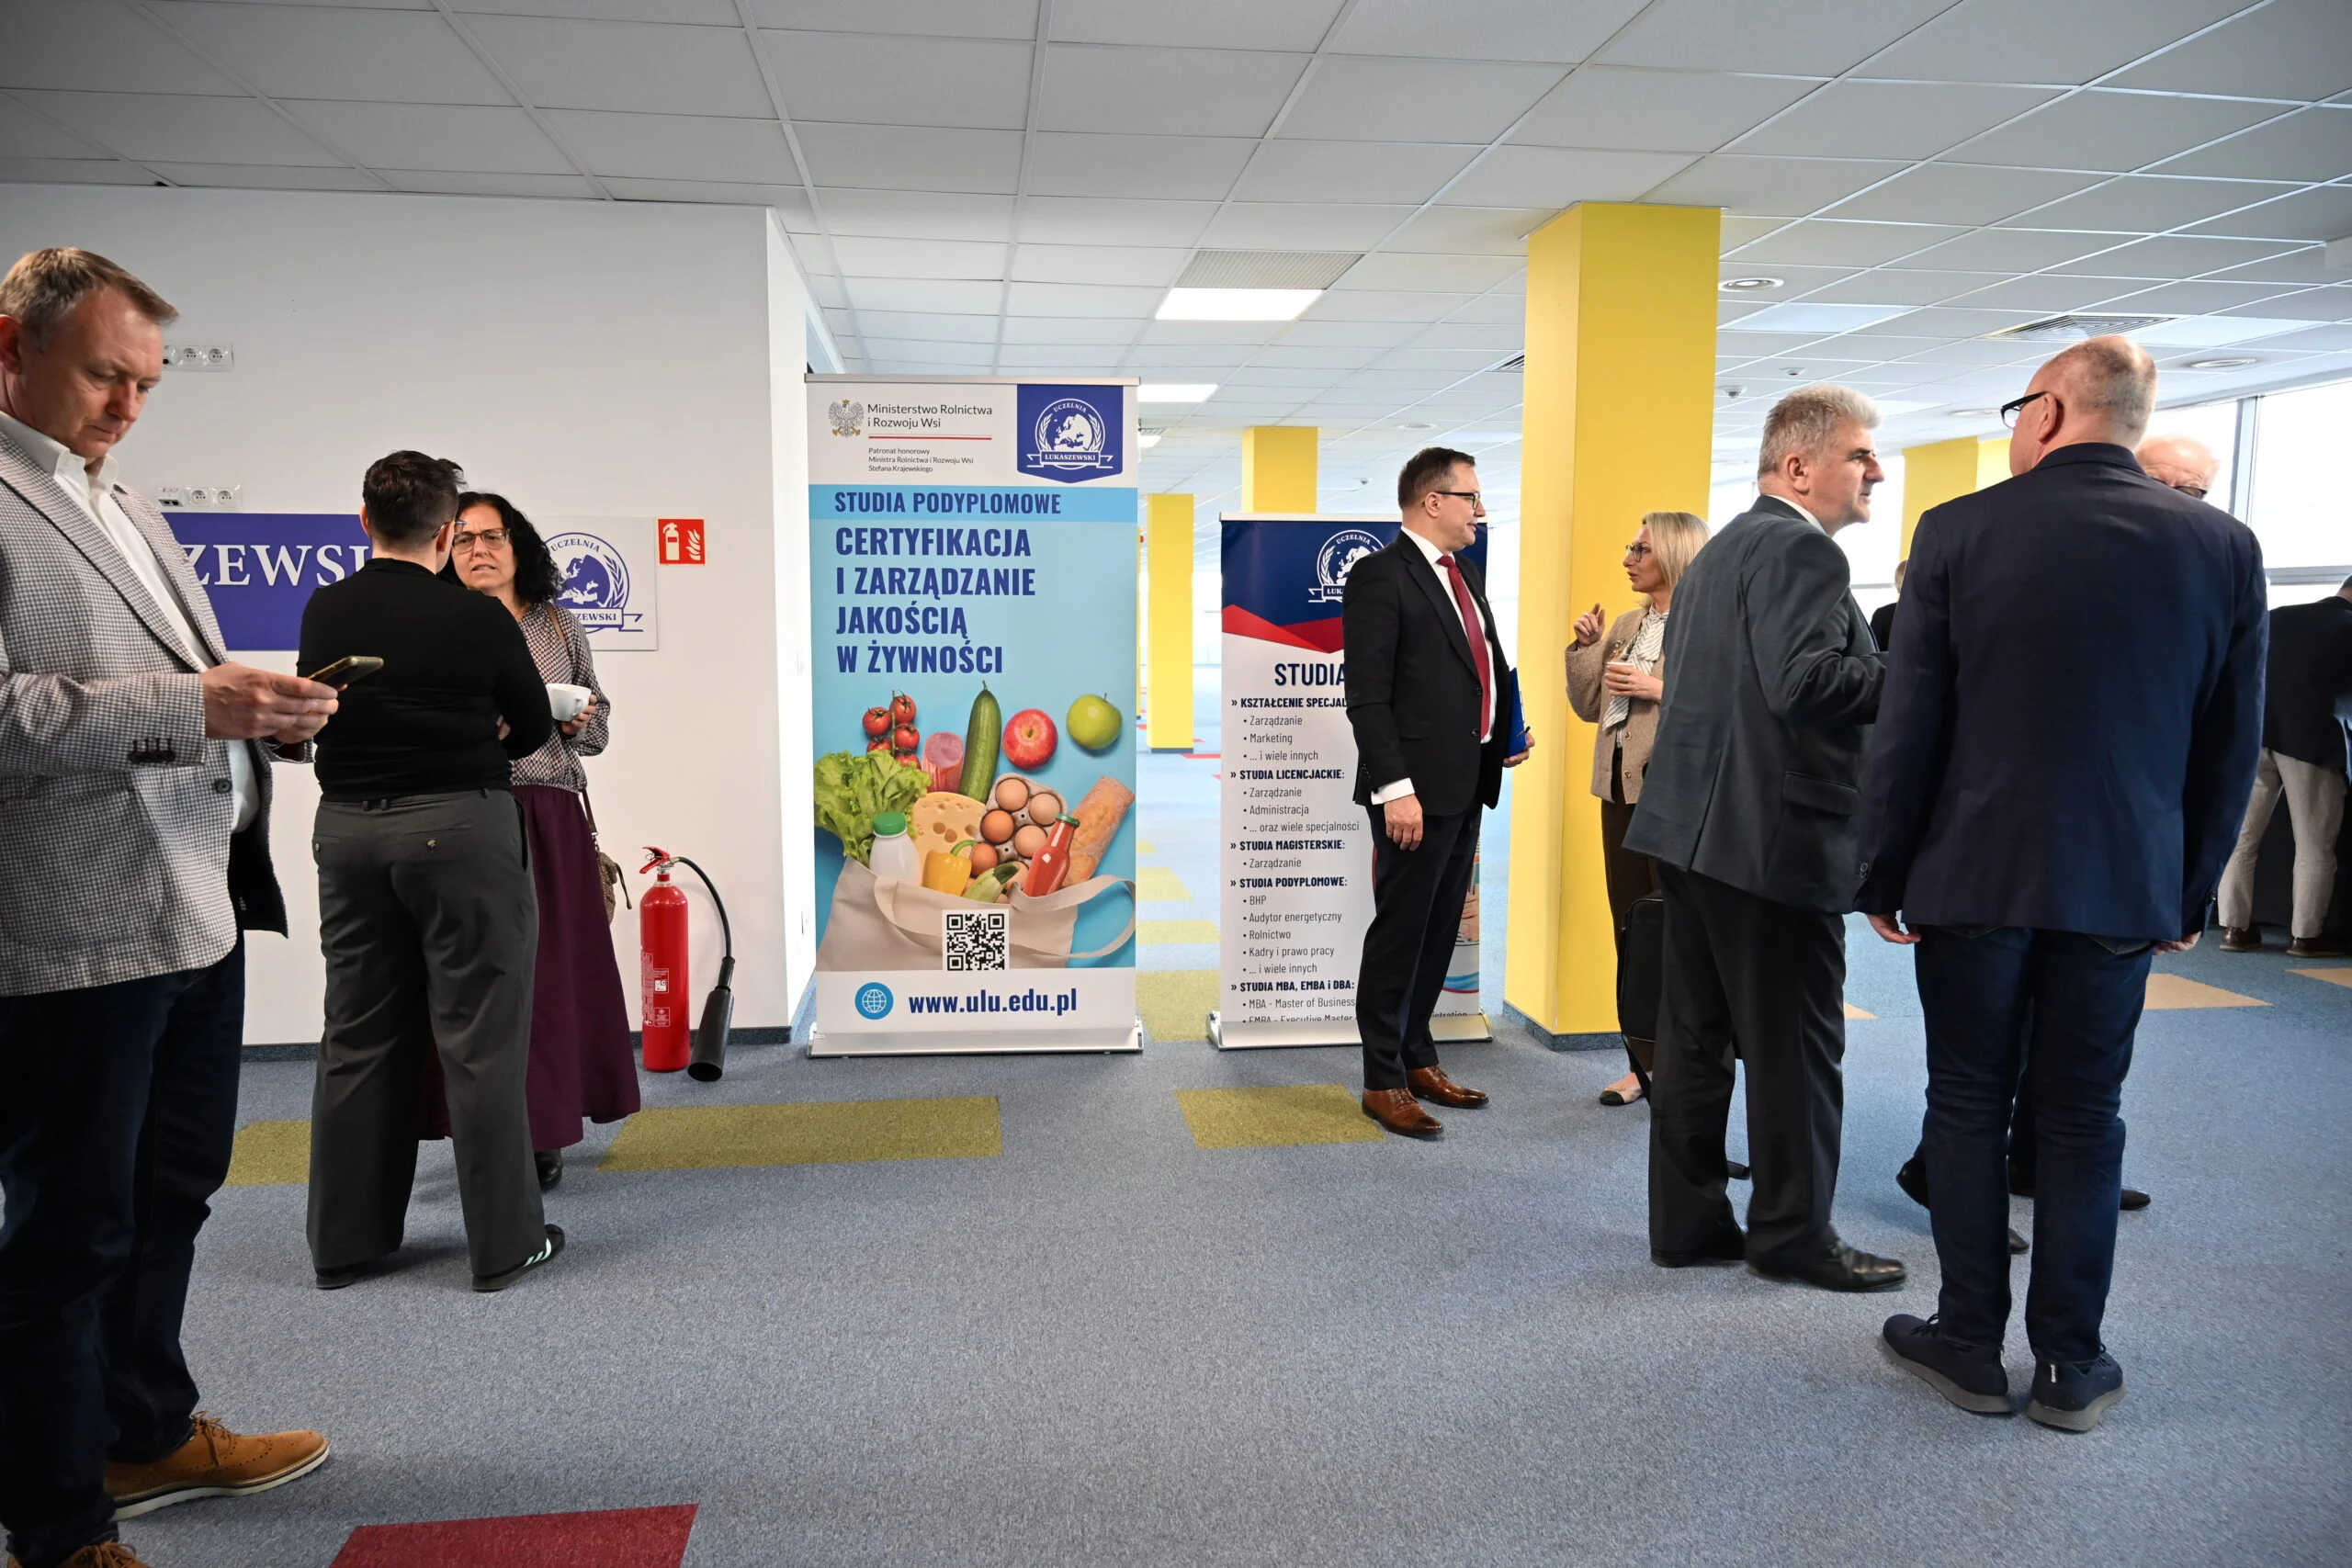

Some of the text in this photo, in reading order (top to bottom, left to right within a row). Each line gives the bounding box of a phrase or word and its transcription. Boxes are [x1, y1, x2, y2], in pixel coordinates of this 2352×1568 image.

[867, 404, 992, 415] Ministerstwo Rolnictwa
[1053, 402, 1087, 413] UCZELNIA
[867, 417, 941, 430] i Rozwoju Wsi
[898, 447, 931, 456] honorowy
[892, 465, 933, 473] Krajewskiego
[835, 491, 1061, 514] STUDIA PODYPLOMOWE
[550, 538, 601, 553] UCZELNIA
[835, 527, 1032, 558] CERTYFIKACJA
[1336, 534, 1371, 546] UCZELNIA
[836, 567, 1035, 601] I ZARZĄDZANIE
[836, 601, 968, 640] JAKOŚCIĄ
[836, 640, 1003, 674] W ŻYWNOŚCI
[1240, 698, 1304, 708] KSZTAŁCENIE
[1250, 716, 1303, 728] Zarządzanie
[1250, 733, 1293, 745] Marketing
[1265, 750, 1288, 761] wiele
[1290, 750, 1318, 762] innych
[1239, 769, 1345, 780] STUDIA LICENCJACKIE:
[1250, 787, 1302, 799] Zarządzanie
[1250, 805, 1309, 817] Administracja
[1260, 823, 1279, 832] oraz
[1281, 821, 1304, 832] wiele
[1306, 820, 1360, 834] specjalności
[1239, 840, 1345, 851] STUDIA MAGISTERSKIE:
[1250, 857, 1302, 870] Zarządzanie
[1239, 876, 1348, 888] STUDIA PODYPLOMOWE:
[1250, 895, 1267, 906] BHP
[1250, 912, 1342, 924] Audytor energetyczny
[1250, 930, 1291, 940] Rolnictwo
[1250, 947, 1274, 959] Kadry
[1282, 948, 1308, 958] prawo
[1310, 947, 1335, 957] pracy
[1264, 964, 1286, 974] wiele
[1289, 963, 1317, 975] innych
[1239, 980, 1355, 992] STUDIA MBA, EMBA i DBA:
[908, 987, 1077, 1016] www.ulu.edu.pl
[1250, 998, 1267, 1009] MBA
[1275, 998, 1303, 1009] Master
[1306, 998, 1315, 1008] of
[1317, 997, 1355, 1008] Business
